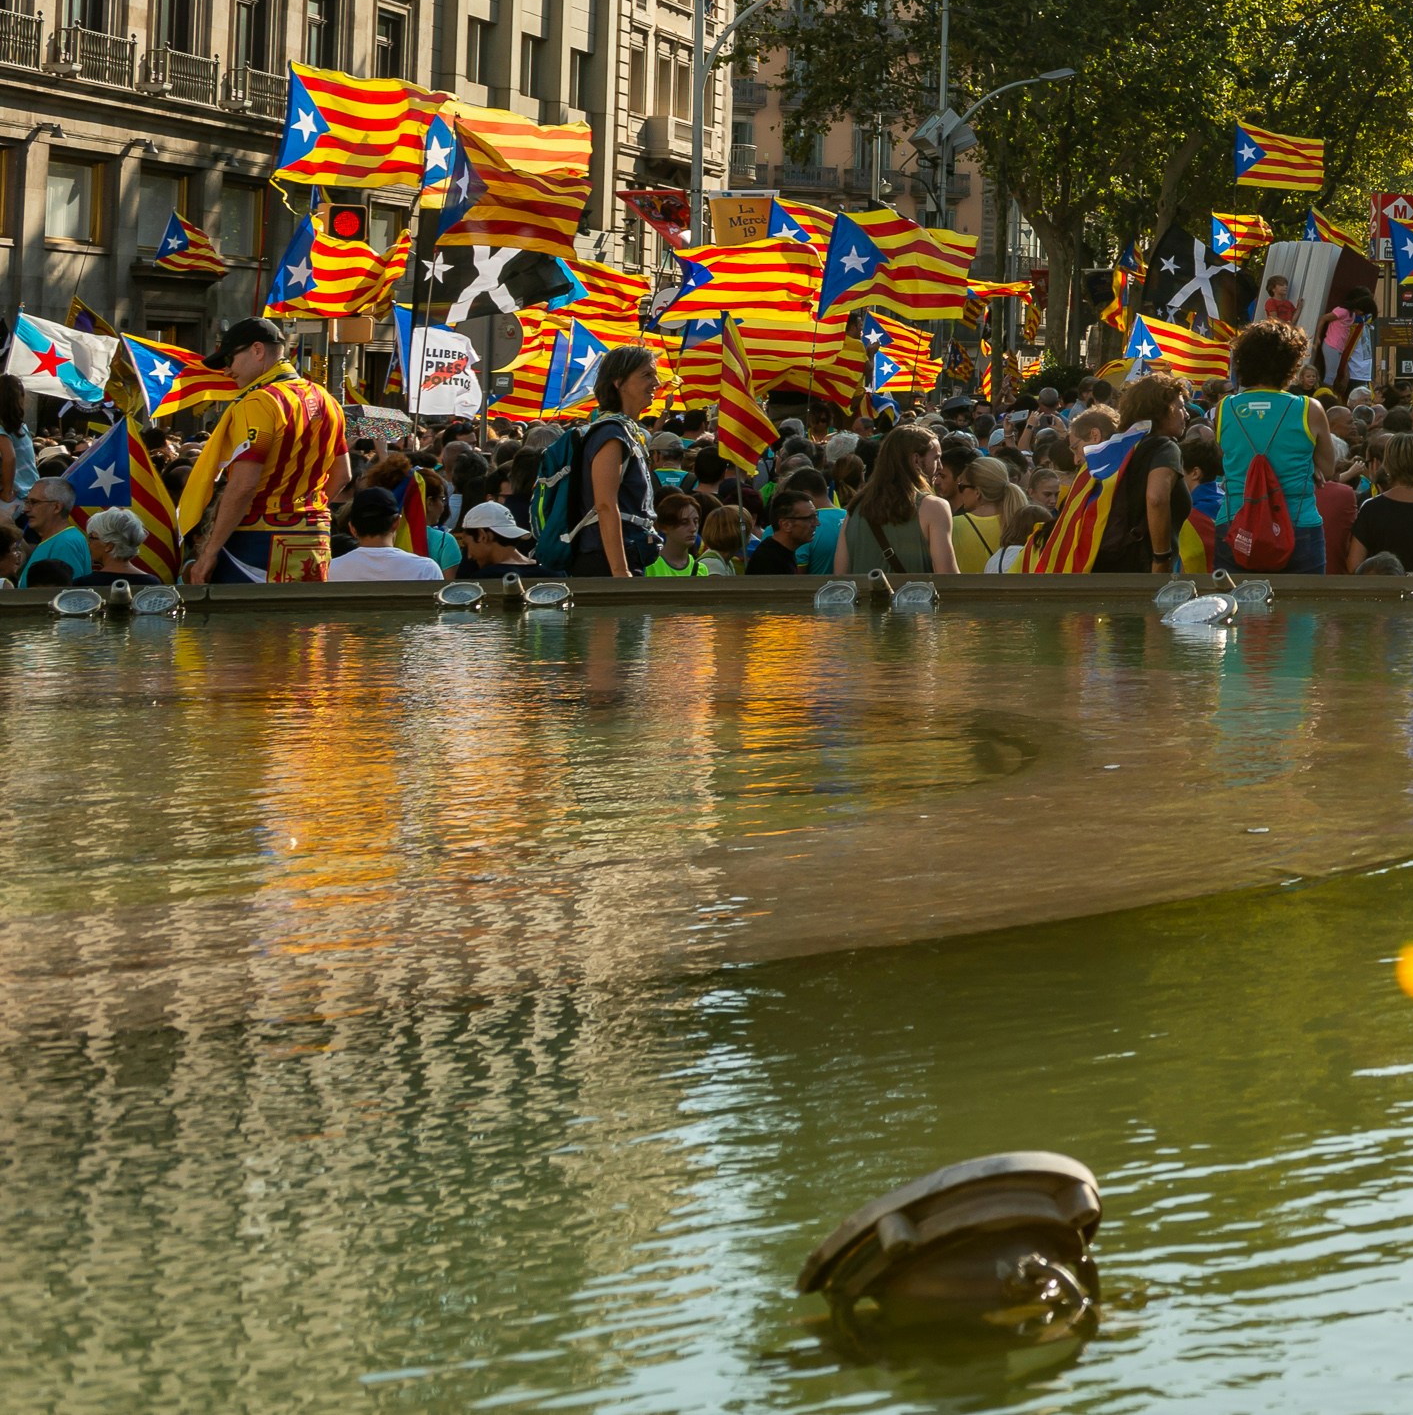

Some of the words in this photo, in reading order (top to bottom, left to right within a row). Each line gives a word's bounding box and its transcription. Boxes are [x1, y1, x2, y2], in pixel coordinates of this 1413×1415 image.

[738, 204, 755, 214] La
[1393, 204, 1407, 220] M
[728, 215, 768, 228] Mercè
[743, 226, 757, 237] 19
